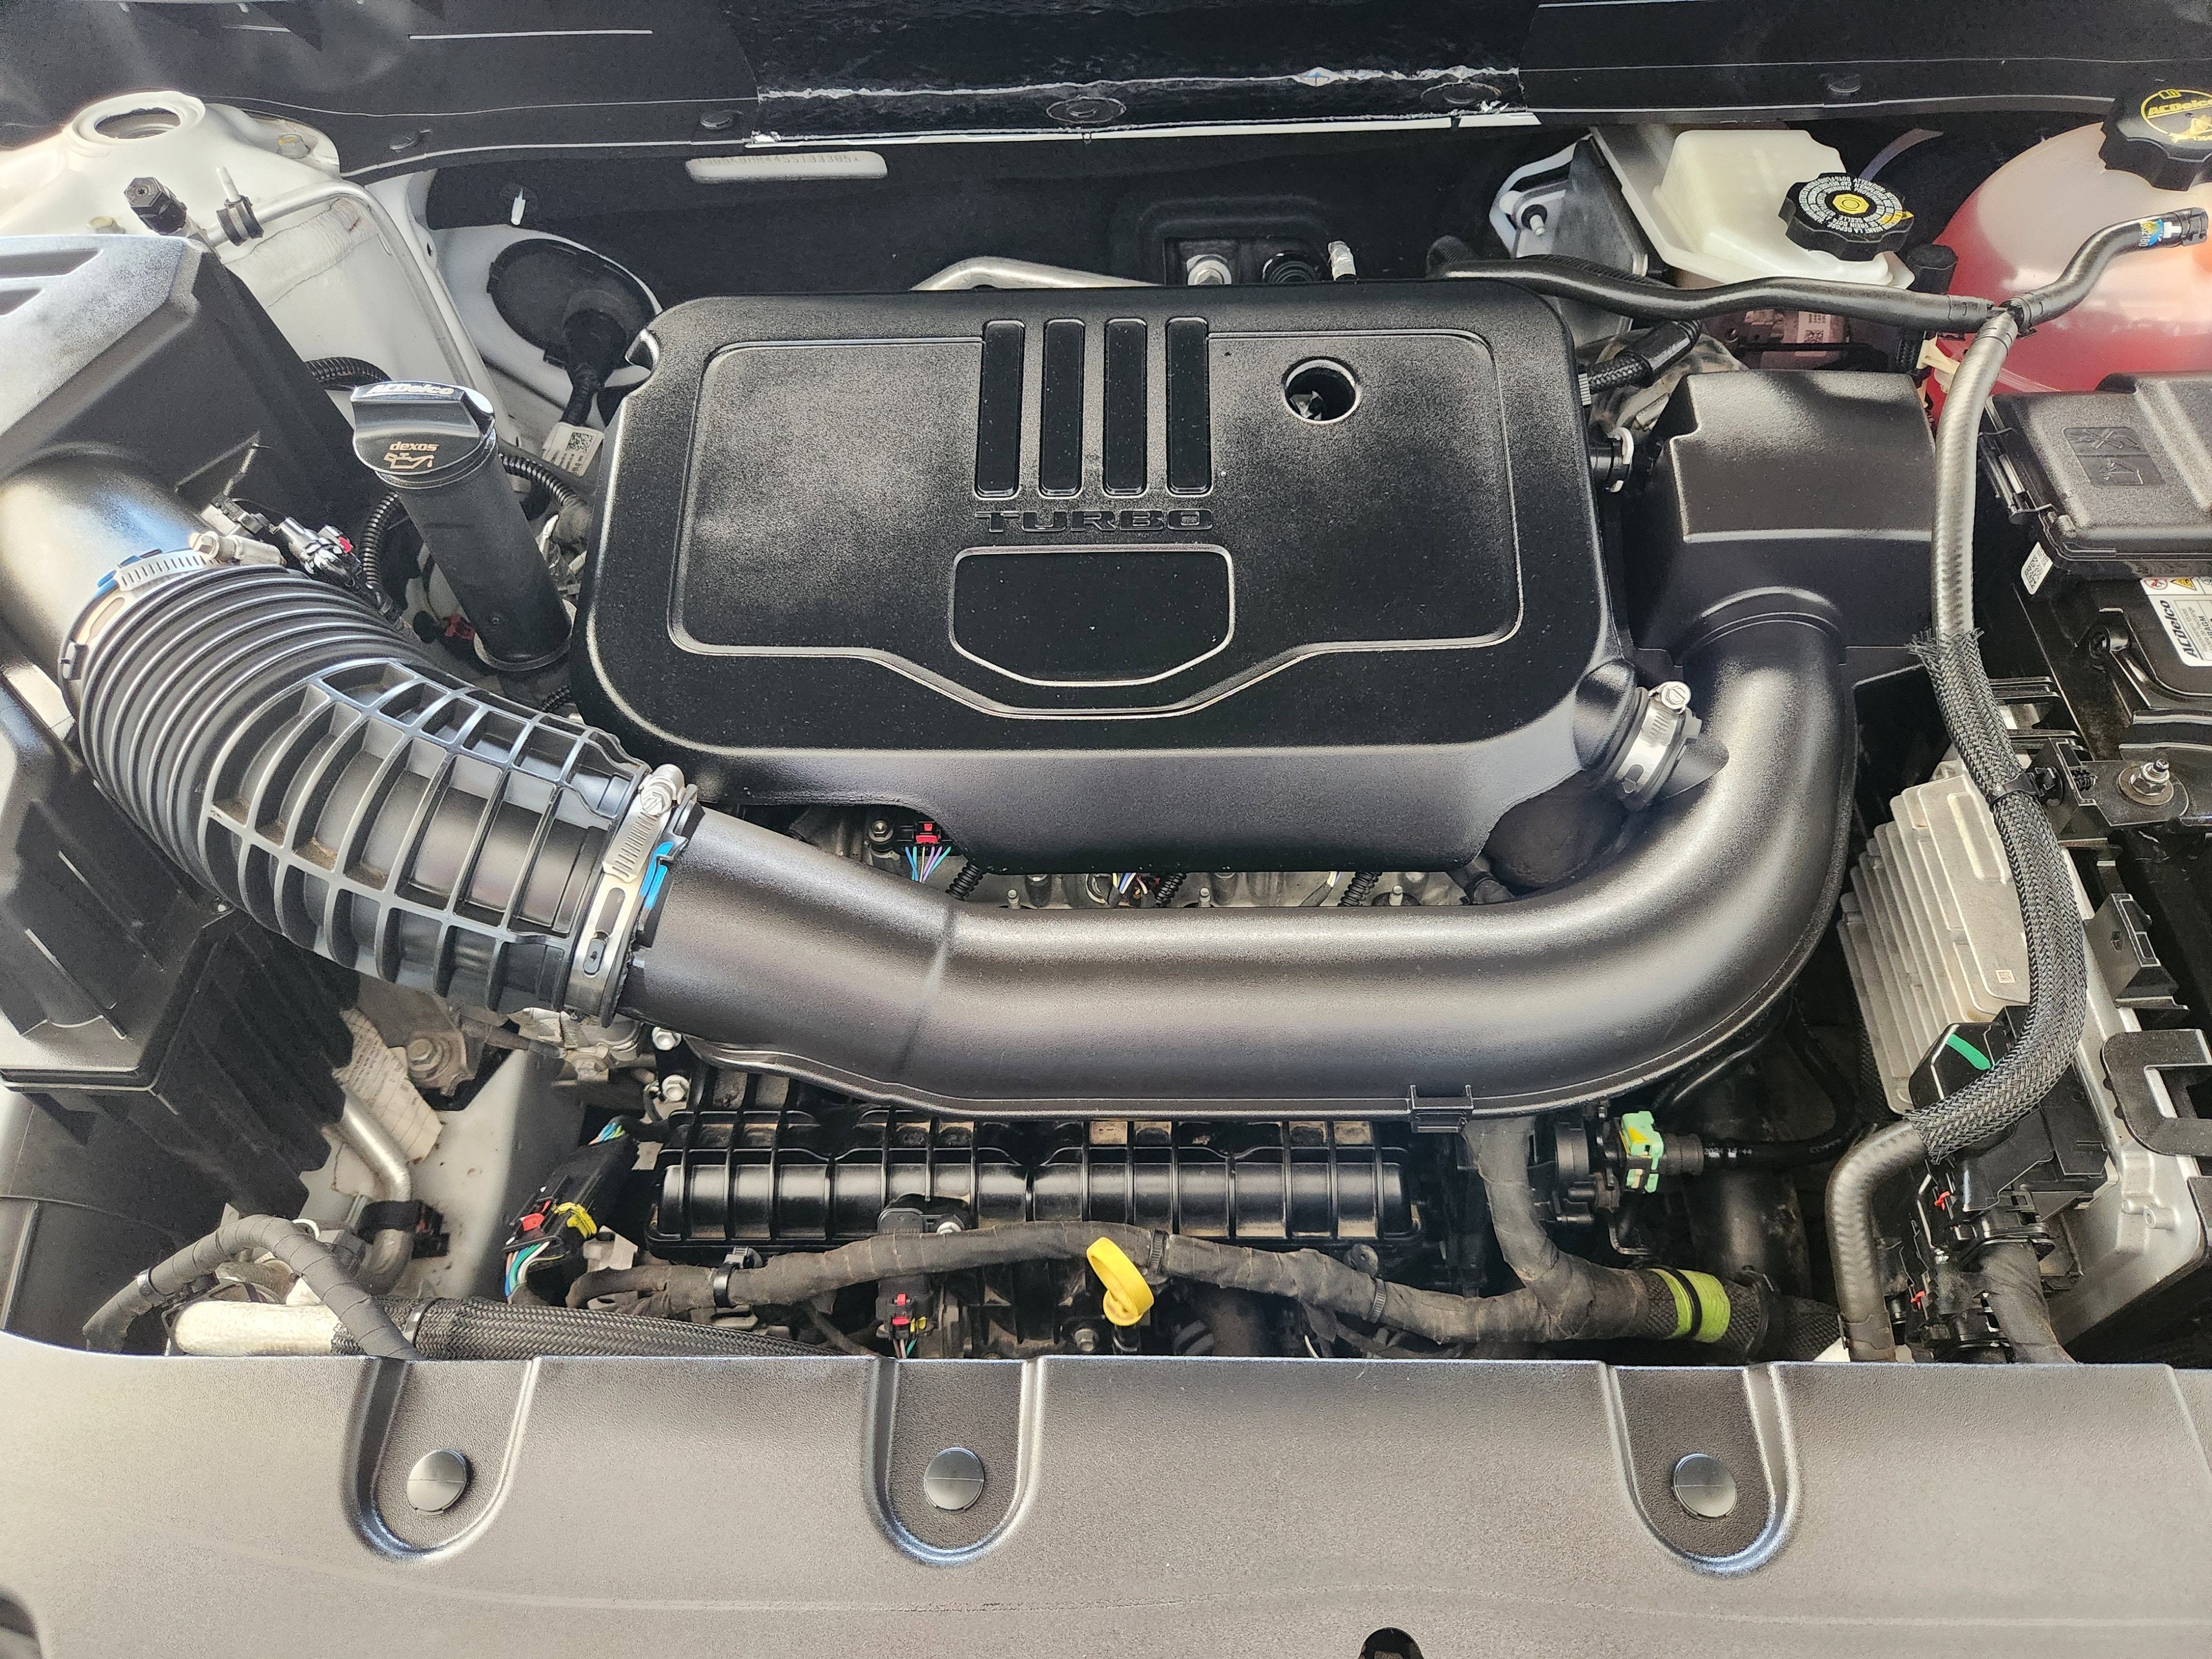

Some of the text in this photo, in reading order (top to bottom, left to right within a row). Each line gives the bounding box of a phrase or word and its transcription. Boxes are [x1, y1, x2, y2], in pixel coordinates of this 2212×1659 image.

[366, 383, 455, 395] ACDelco
[389, 441, 440, 451] dexos
[975, 509, 1213, 533] TURBO
[2160, 600, 2199, 658] ACDelco
